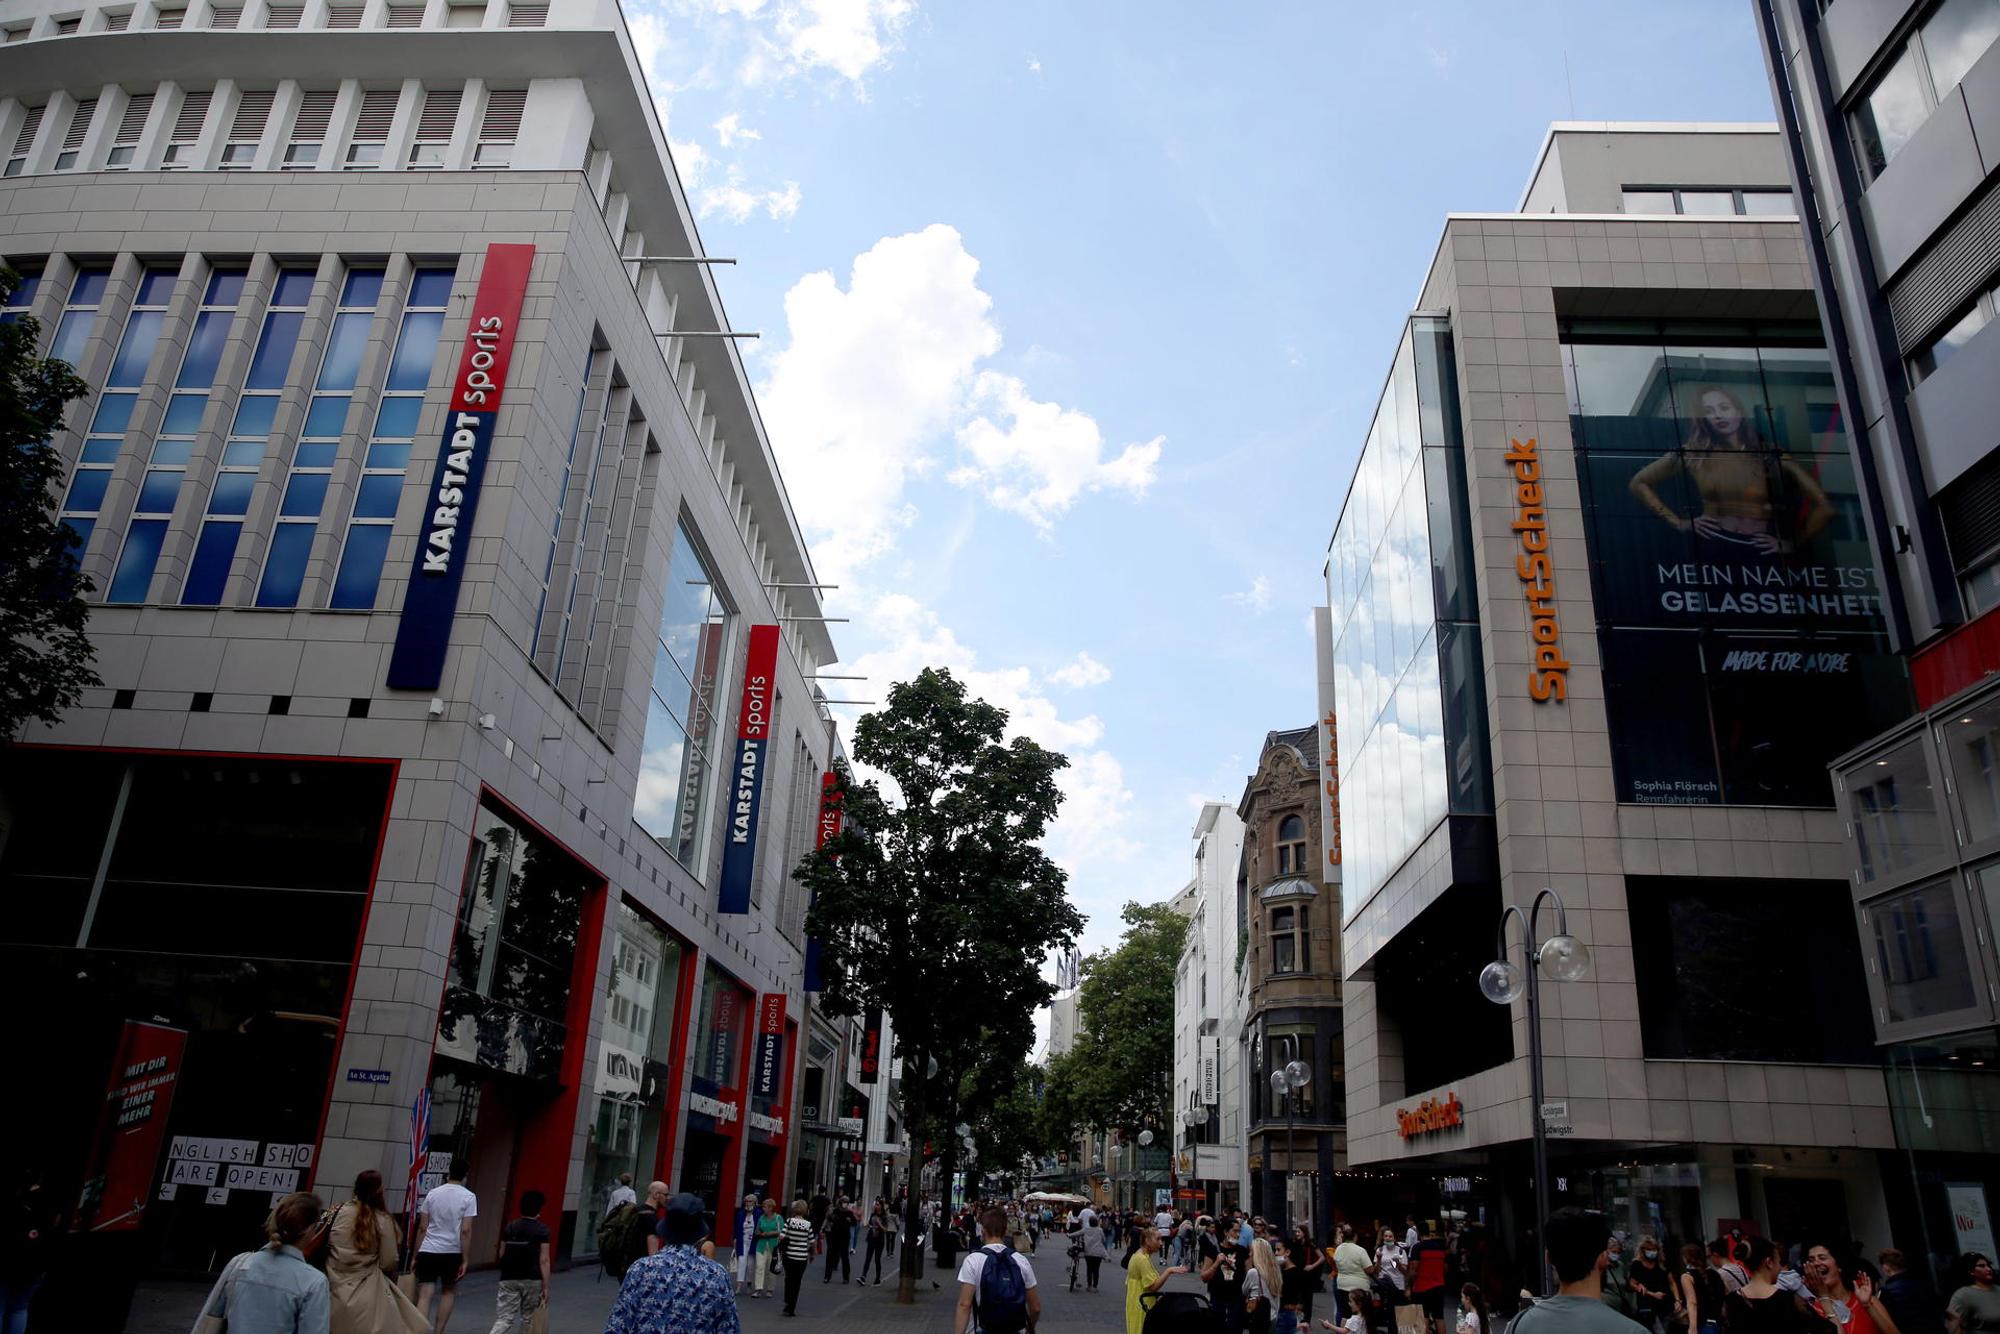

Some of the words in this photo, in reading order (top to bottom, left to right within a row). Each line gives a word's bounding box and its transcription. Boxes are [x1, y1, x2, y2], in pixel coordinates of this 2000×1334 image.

[421, 410, 480, 574] KARSTADT
[463, 313, 503, 406] sports
[1504, 438, 1569, 703] SportScheck
[1657, 563, 1733, 585] MEIN
[1741, 566, 1829, 588] NAME
[1836, 567, 1876, 588] IST
[1661, 590, 1883, 616] GELASSENHEIT
[1721, 651, 1769, 672] MADE
[1771, 652, 1802, 672] FOR
[1804, 652, 1849, 673] MORE
[732, 740, 760, 843] KARSTADT
[746, 675, 766, 735] sports
[1633, 780, 1673, 792] Sophia
[761, 1034, 775, 1092] KARSTADT
[768, 998, 779, 1034] sports
[124, 1060, 147, 1078] MIT
[147, 1056, 167, 1073] DIR
[349, 1071, 358, 1079] An
[146, 1072, 176, 1089] IMMER
[121, 1089, 154, 1110] EINER
[116, 1105, 153, 1127] MEHR
[1545, 1125, 1575, 1137] udwigstr.
[174, 1164, 216, 1181] ARE
[228, 1169, 294, 1188] OPEN!
